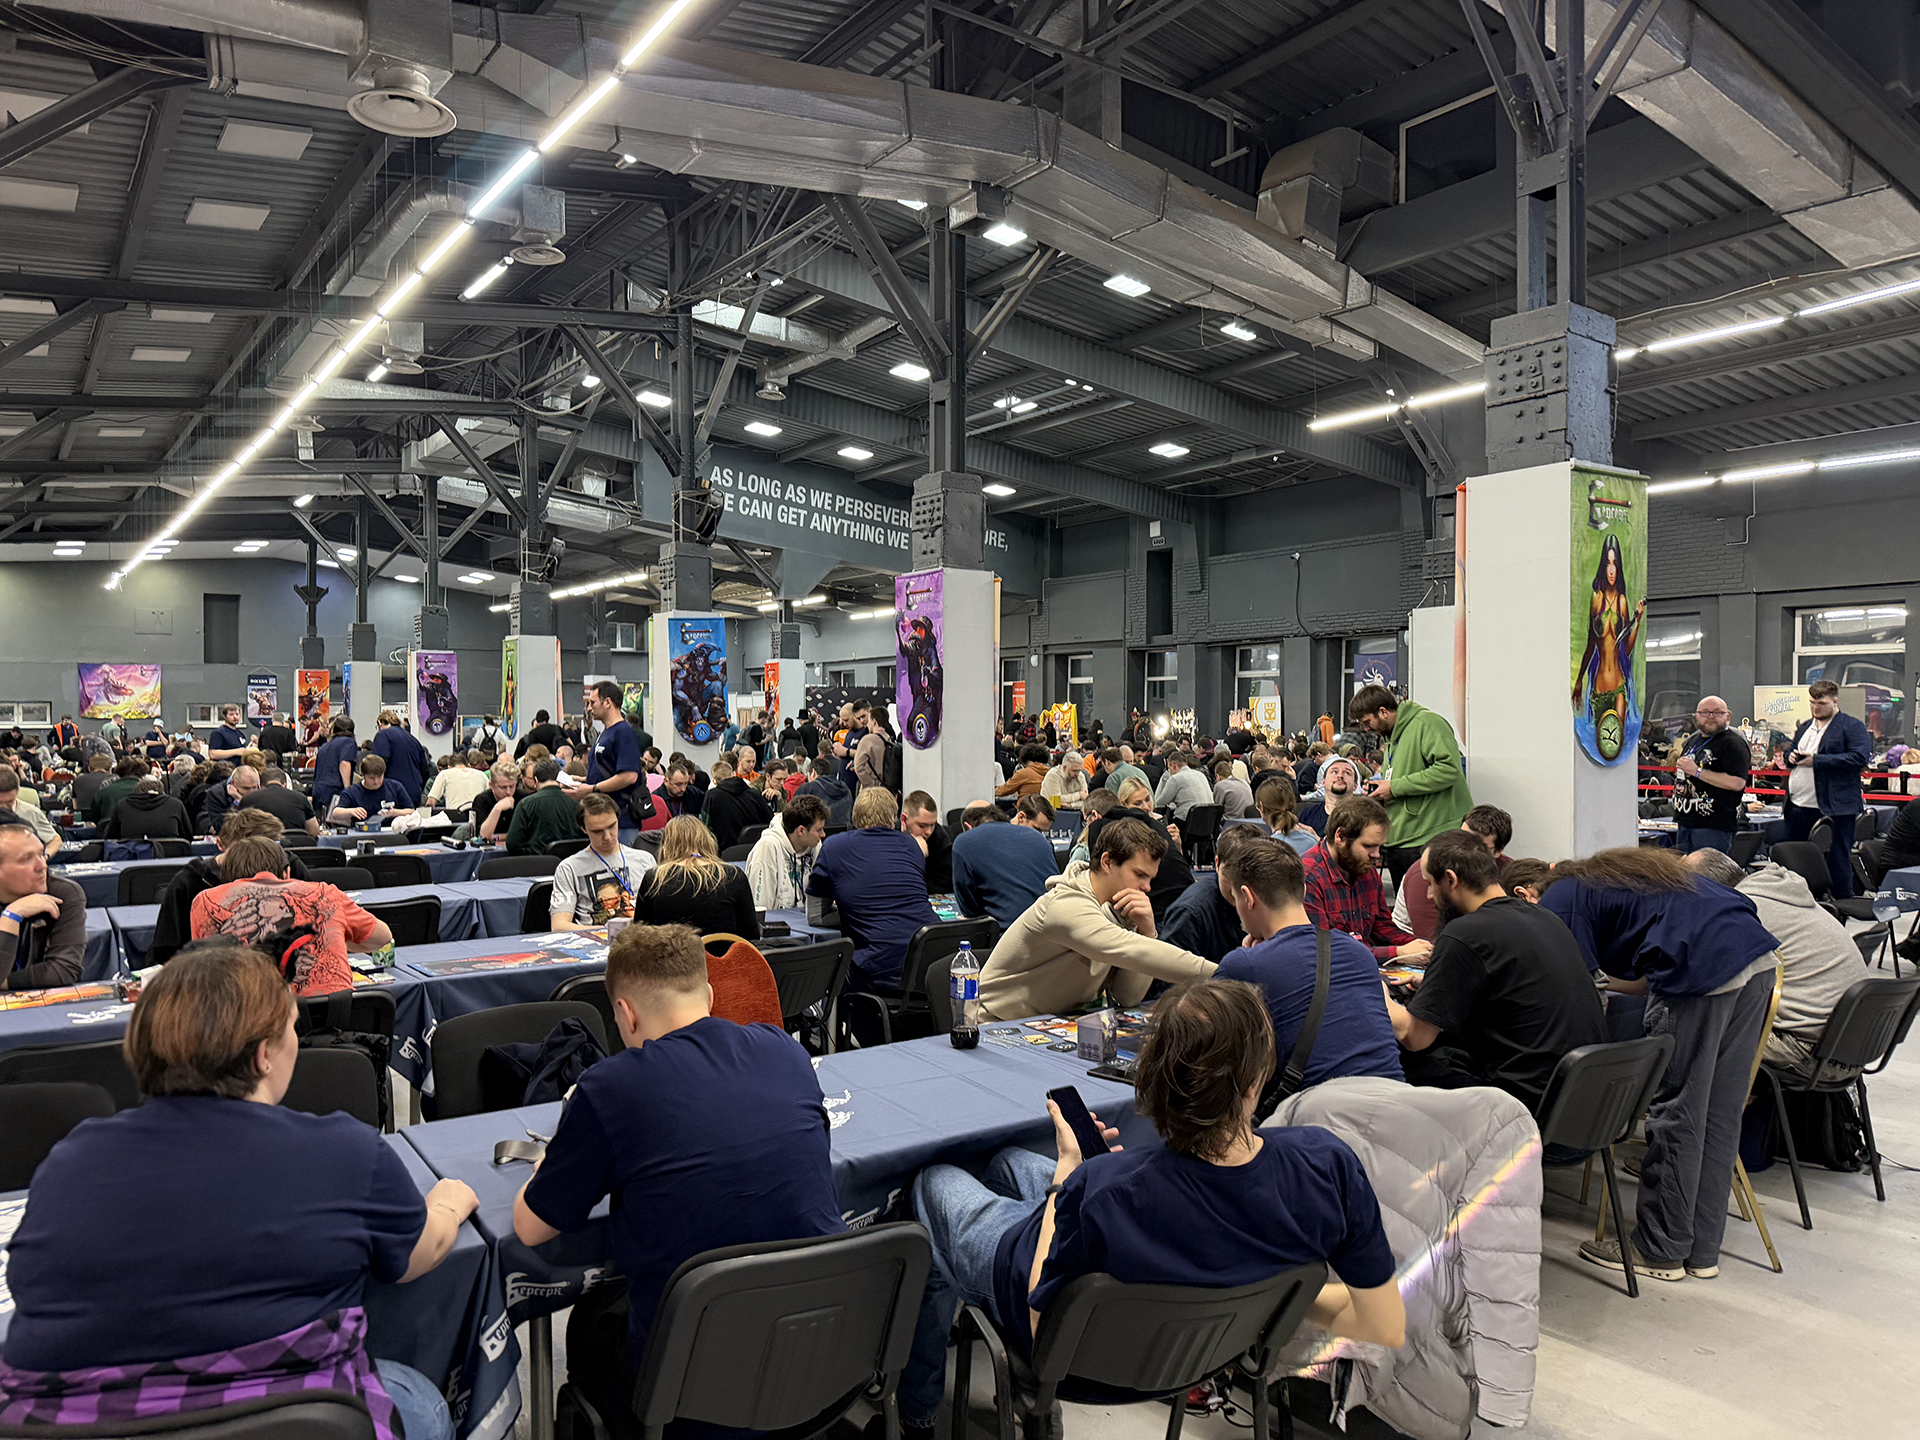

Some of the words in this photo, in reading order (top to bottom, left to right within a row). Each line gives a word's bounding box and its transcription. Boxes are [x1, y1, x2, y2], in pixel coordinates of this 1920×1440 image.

[710, 465, 734, 488] AS
[737, 471, 782, 499] LONG
[784, 483, 807, 505] AS
[810, 488, 833, 511] WE
[835, 494, 912, 529] PERSEVER
[738, 496, 773, 520] CAN
[777, 504, 808, 527] GET
[809, 512, 885, 545] ANYTHING
[887, 528, 910, 551] WE
